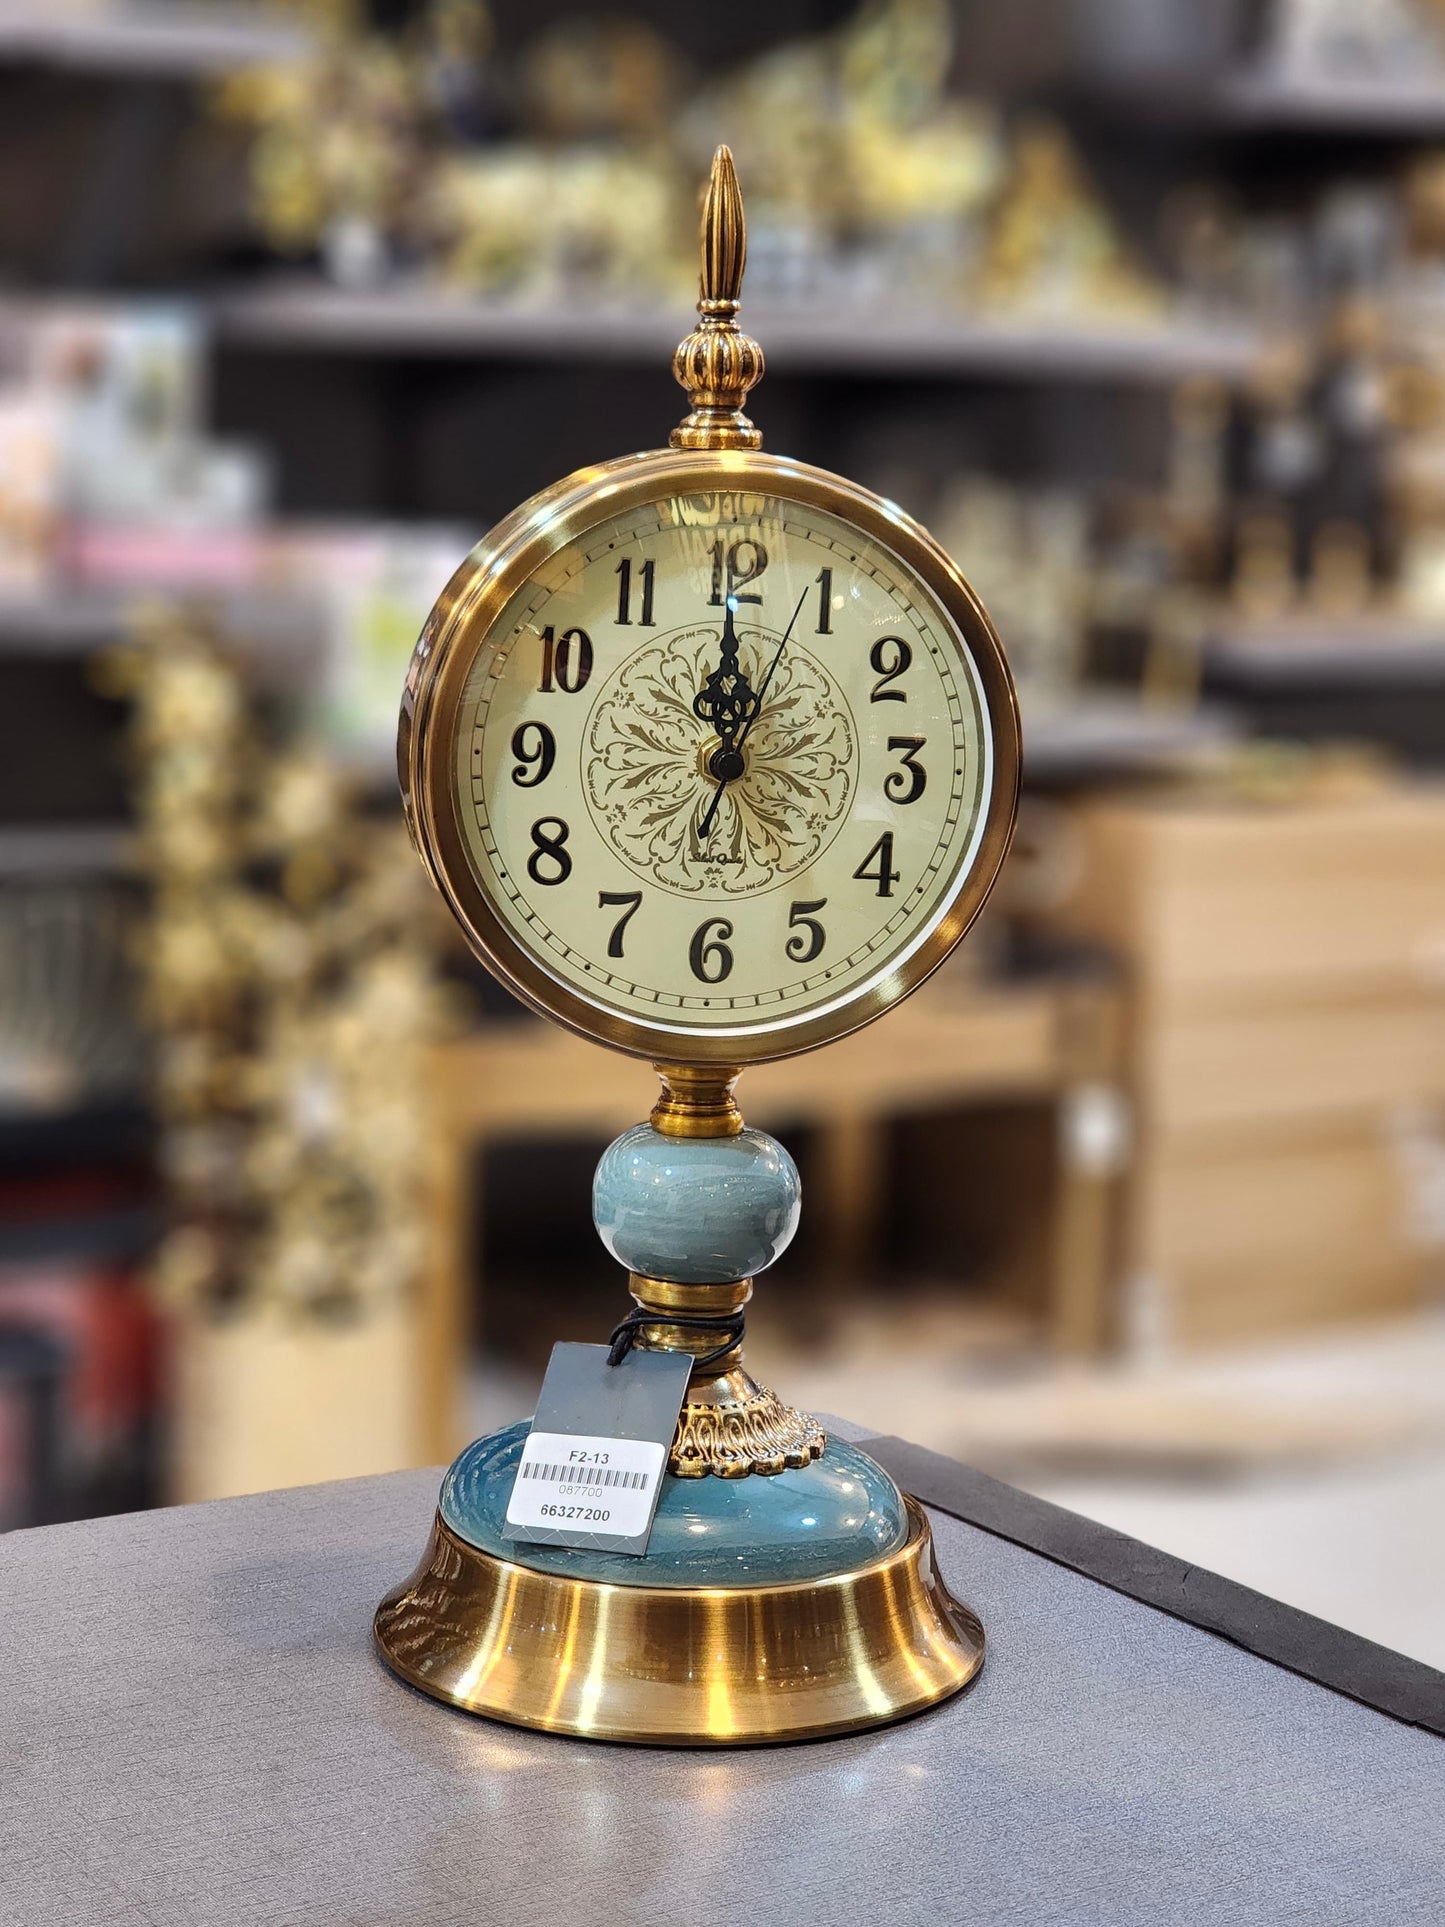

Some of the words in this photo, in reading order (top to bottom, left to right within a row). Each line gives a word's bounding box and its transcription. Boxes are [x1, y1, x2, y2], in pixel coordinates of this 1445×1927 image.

[615, 557, 656, 626] 11
[707, 538, 768, 606] 12
[814, 567, 833, 635] 1
[538, 625, 594, 694] 10
[870, 636, 913, 703] 2
[511, 720, 555, 788] 9
[885, 737, 927, 805] 3
[527, 816, 572, 885] 8
[853, 831, 900, 897] 4
[598, 891, 643, 958] 7
[689, 917, 734, 984] 6
[786, 898, 826, 963] 5
[558, 1484, 602, 1497] 087700
[569, 1450, 610, 1464] F2-13
[540, 1504, 610, 1521] 66327200
